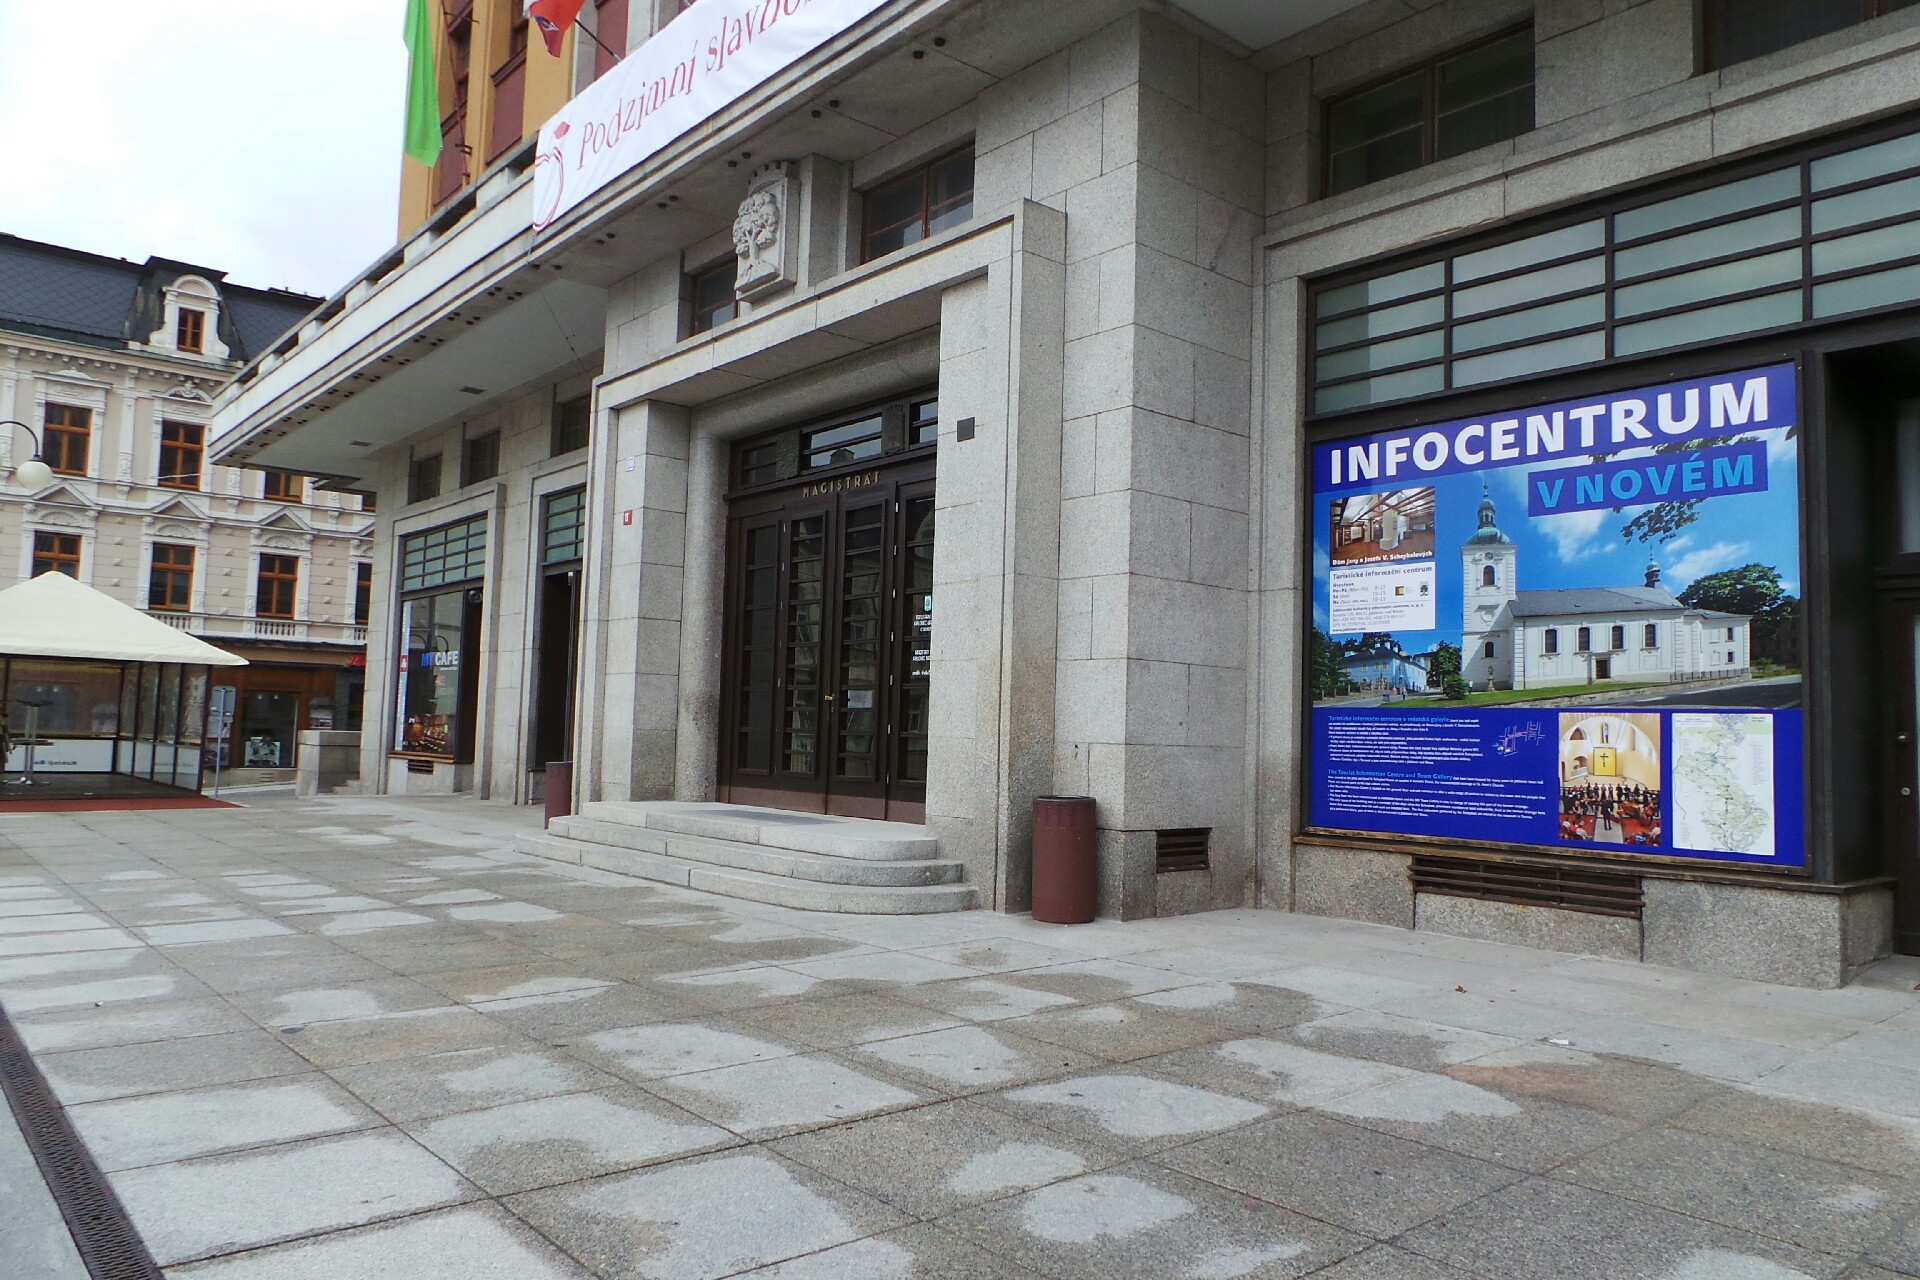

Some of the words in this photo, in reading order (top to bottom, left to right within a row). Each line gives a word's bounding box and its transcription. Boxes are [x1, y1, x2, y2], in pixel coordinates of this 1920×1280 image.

[575, 38, 698, 171] Podzimní
[1330, 376, 1769, 485] INFOCENTRUM
[802, 470, 880, 498] MAGISTRÁT
[1536, 478, 1565, 508] V
[1575, 452, 1754, 505] NOVÉM
[1364, 556, 1382, 564] Josefa
[1333, 571, 1364, 580] Turistické
[1365, 567, 1401, 577] informační
[1403, 566, 1433, 574] centrum
[434, 650, 459, 666] CAFE
[1432, 773, 1453, 781] Gallery
